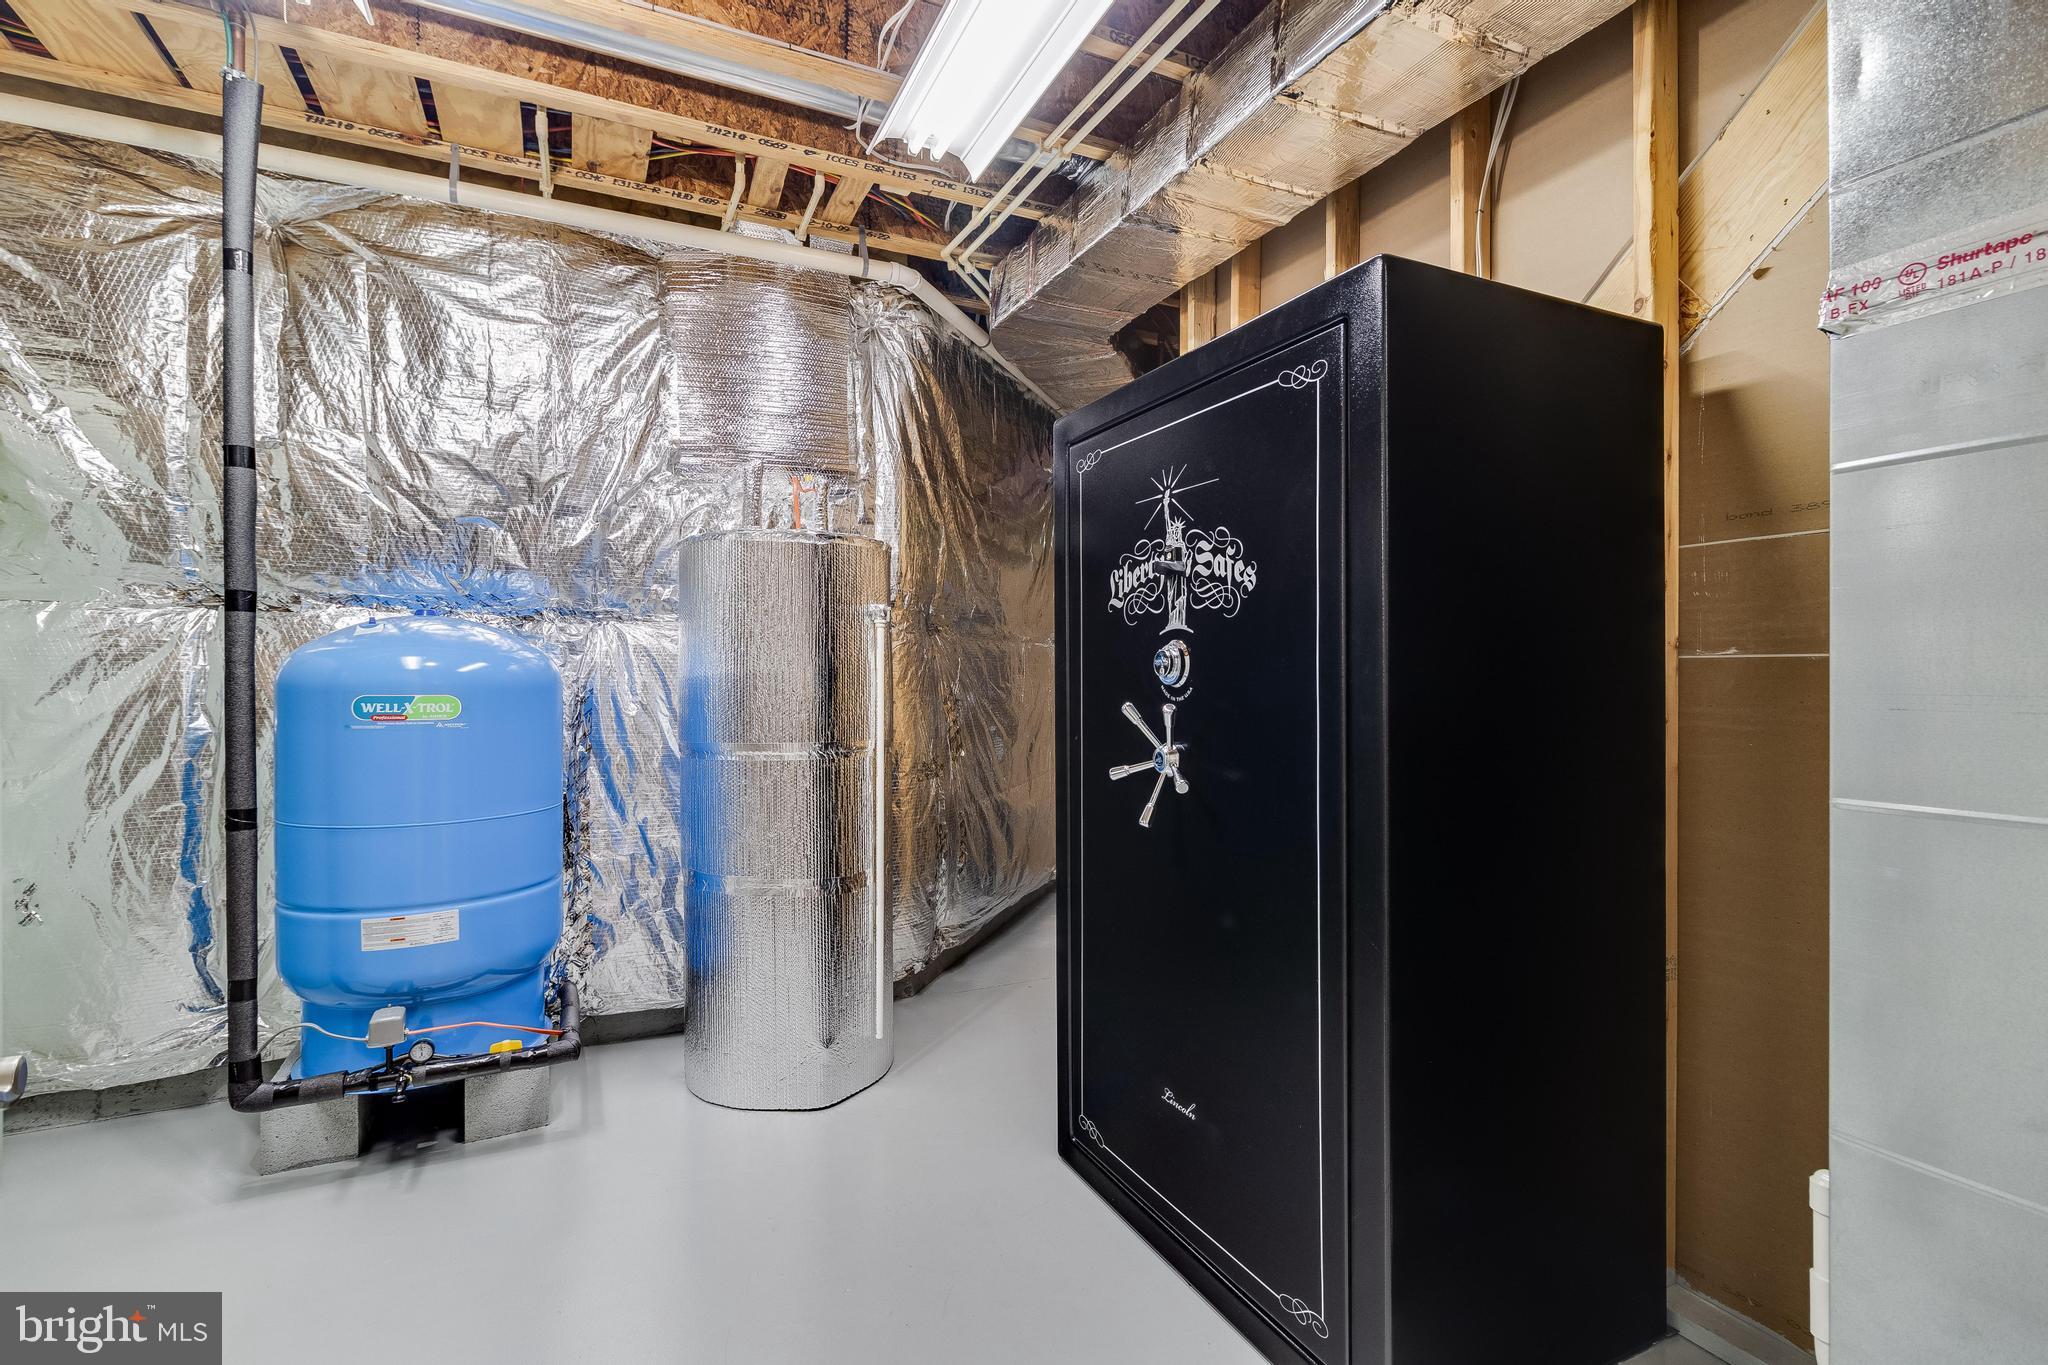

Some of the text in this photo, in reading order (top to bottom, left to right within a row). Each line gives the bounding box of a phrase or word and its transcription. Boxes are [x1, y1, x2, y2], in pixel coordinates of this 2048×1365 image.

[758, 138, 788, 150] 0569
[825, 153, 859, 168] ICCES
[864, 164, 917, 181] ESR-1153
[931, 179, 958, 191] CCMC
[962, 187, 994, 199] 13132
[671, 190, 694, 201] HUD
[1936, 232, 2033, 270] Shurtape
[1852, 277, 1882, 296] 100
[1937, 260, 2003, 289] 181A-P
[1192, 540, 1258, 600] Safes
[1161, 1087, 1196, 1121] Lincoln
